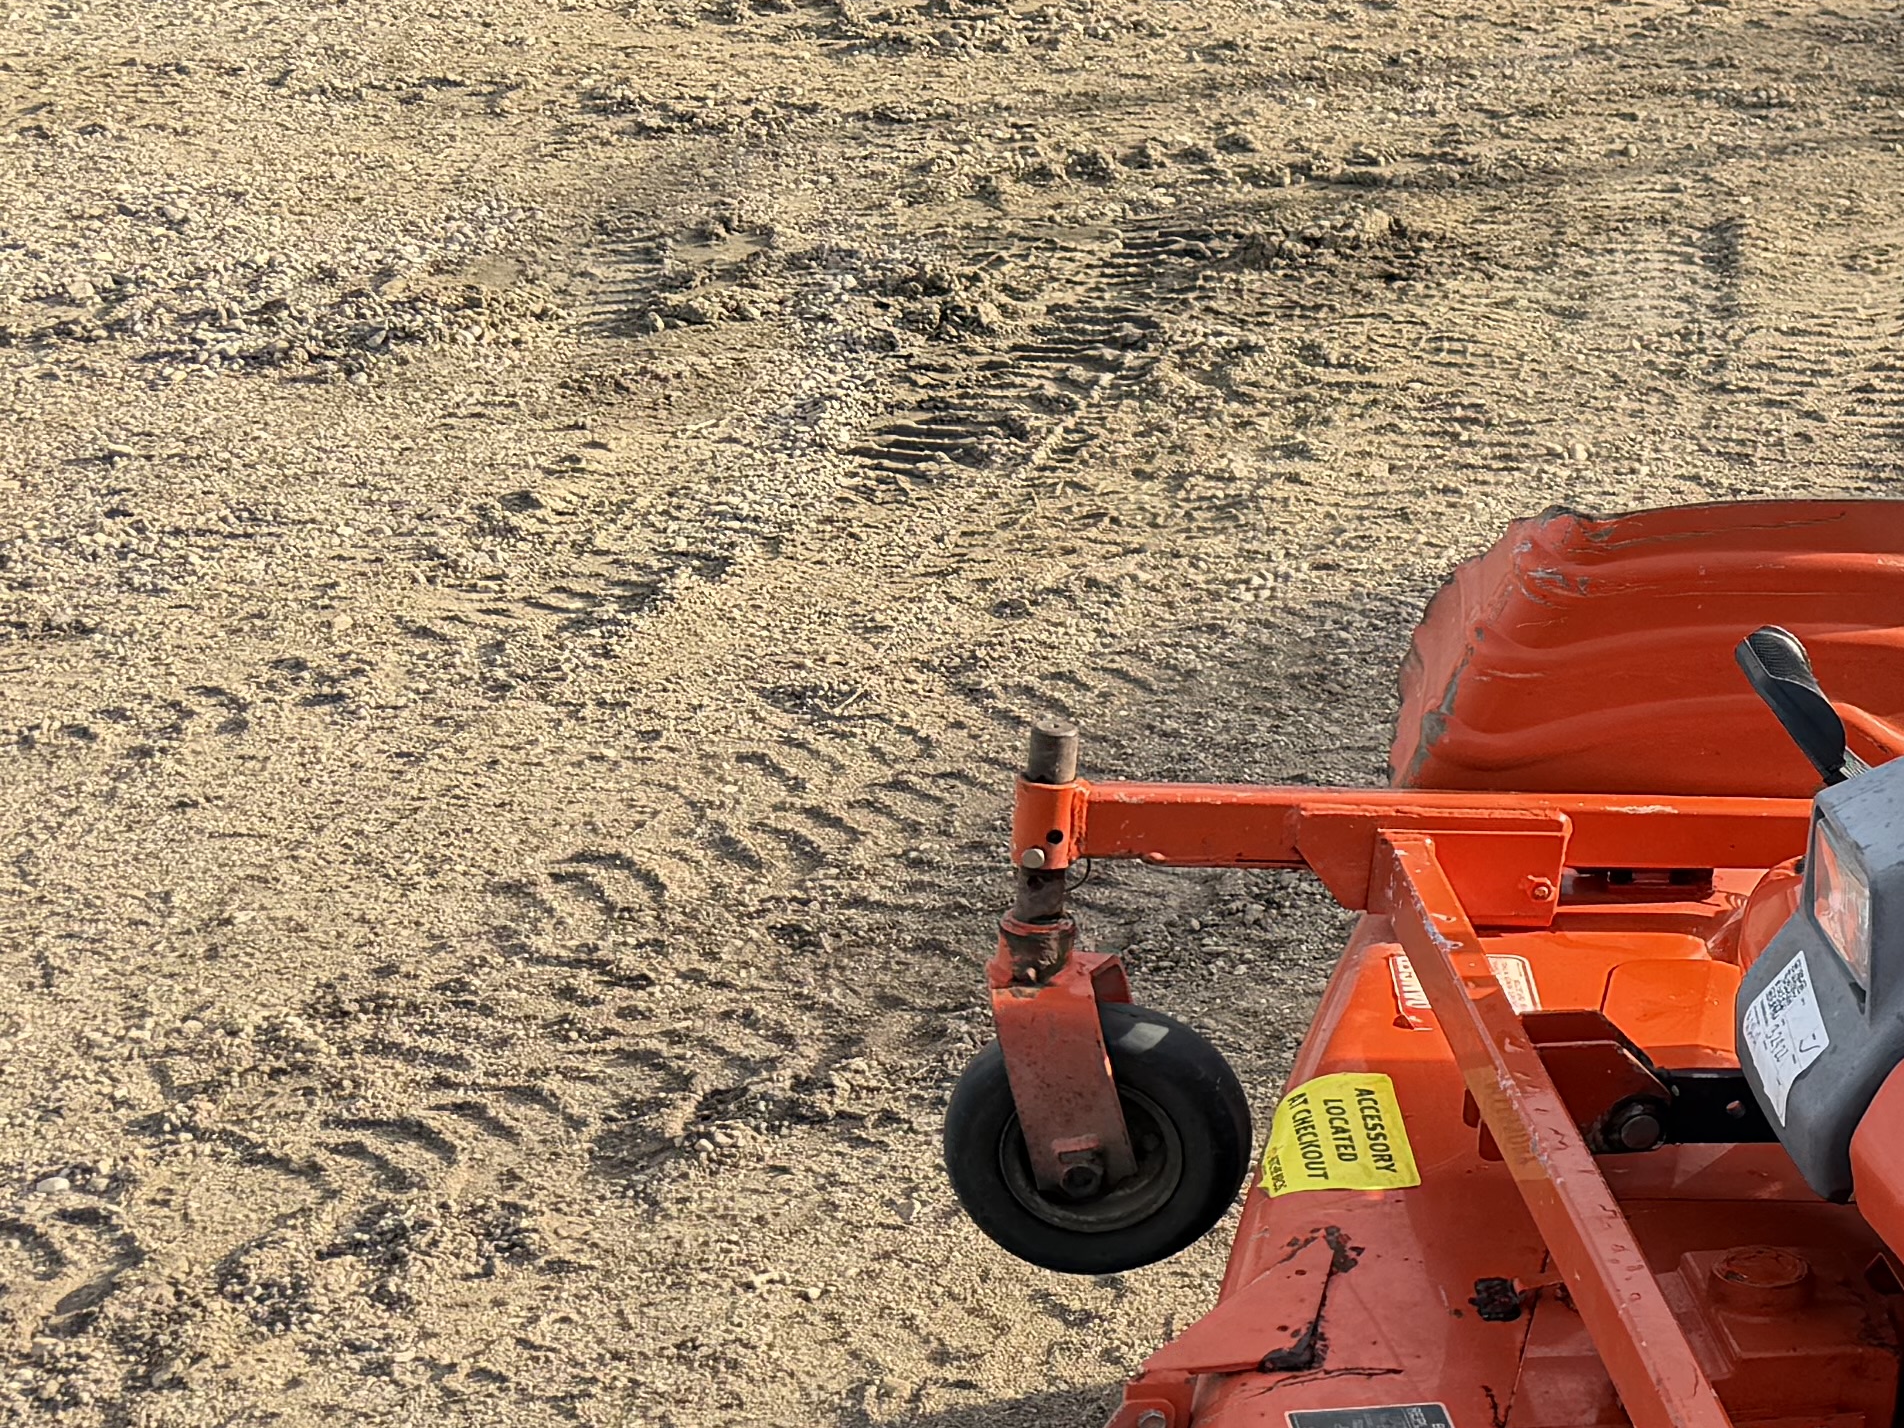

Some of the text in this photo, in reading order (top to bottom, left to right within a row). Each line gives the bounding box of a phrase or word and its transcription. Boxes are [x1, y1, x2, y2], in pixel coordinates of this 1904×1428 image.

[1287, 1092, 1329, 1180] AT CHECKOUT
[1323, 1098, 1358, 1162] LOCATED
[1354, 1087, 1397, 1173] ACCESSORY
